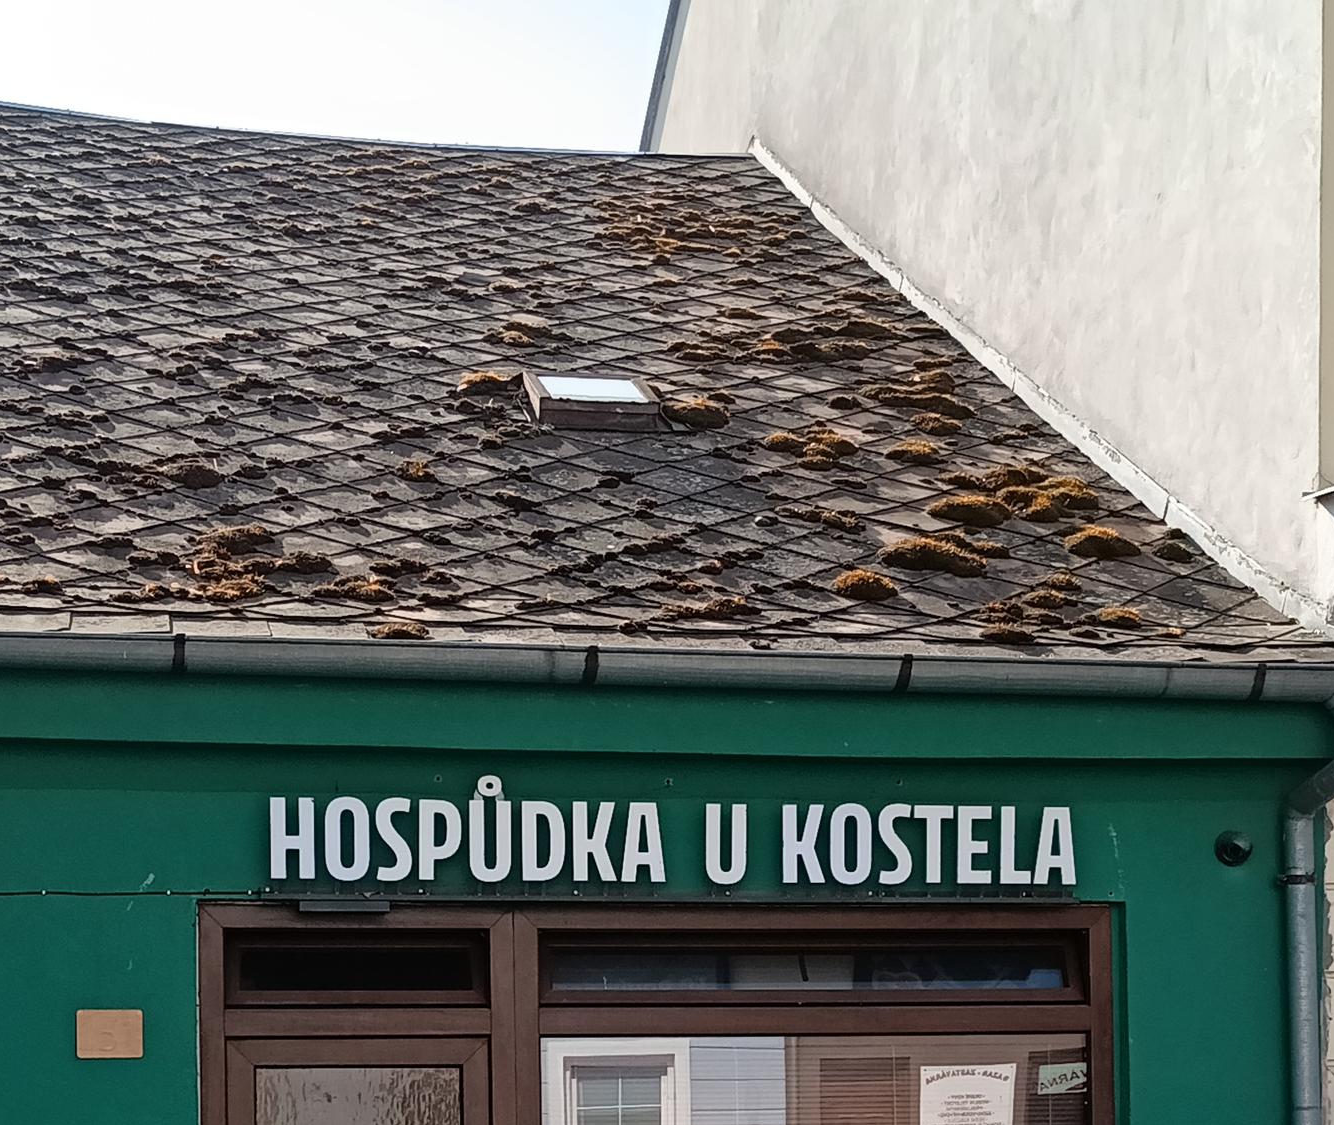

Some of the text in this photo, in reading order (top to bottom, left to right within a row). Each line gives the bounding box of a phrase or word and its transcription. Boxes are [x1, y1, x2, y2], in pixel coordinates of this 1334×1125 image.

[269, 774, 1077, 886] HOSPŮDKA U KOSTELA
